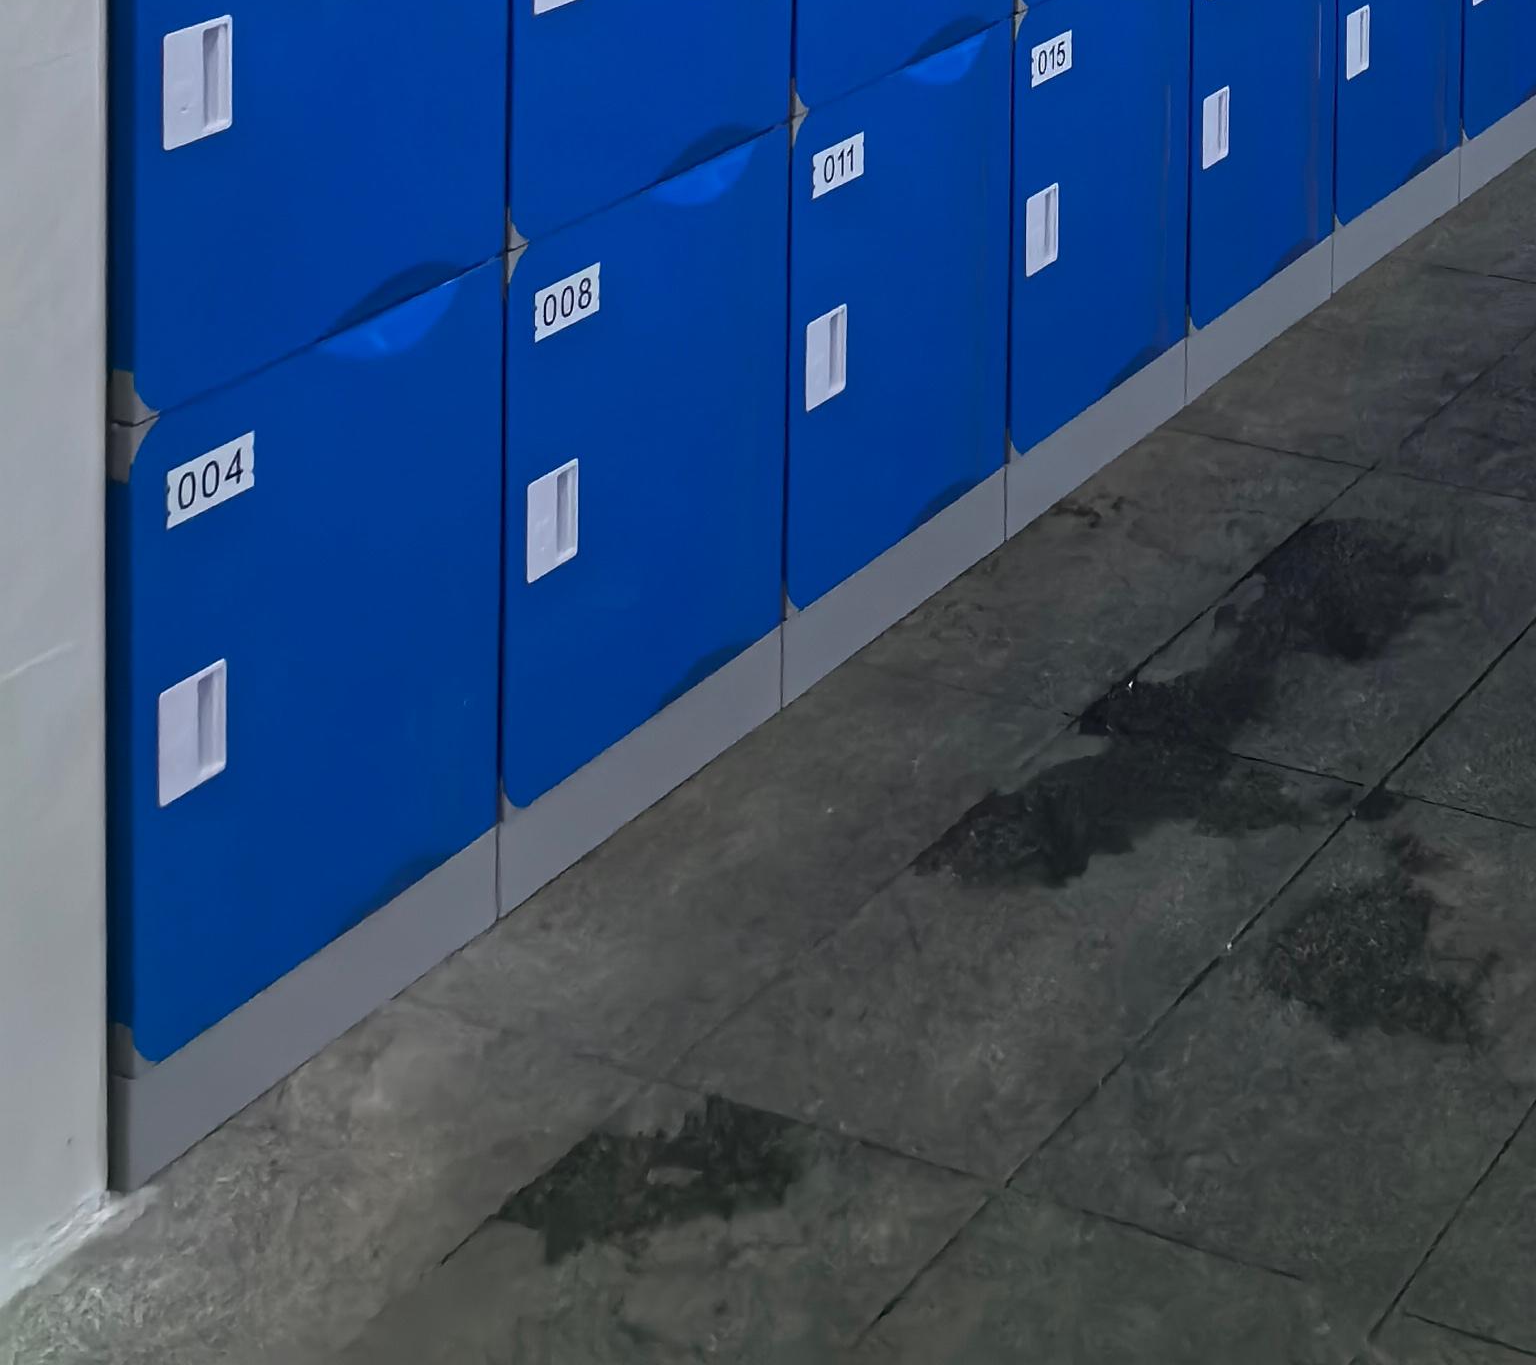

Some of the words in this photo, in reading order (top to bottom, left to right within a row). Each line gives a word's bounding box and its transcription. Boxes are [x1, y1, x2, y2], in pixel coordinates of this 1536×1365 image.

[1038, 41, 1065, 75] 015
[824, 145, 853, 183] 011
[543, 278, 592, 326] 008
[178, 448, 243, 509] 004
